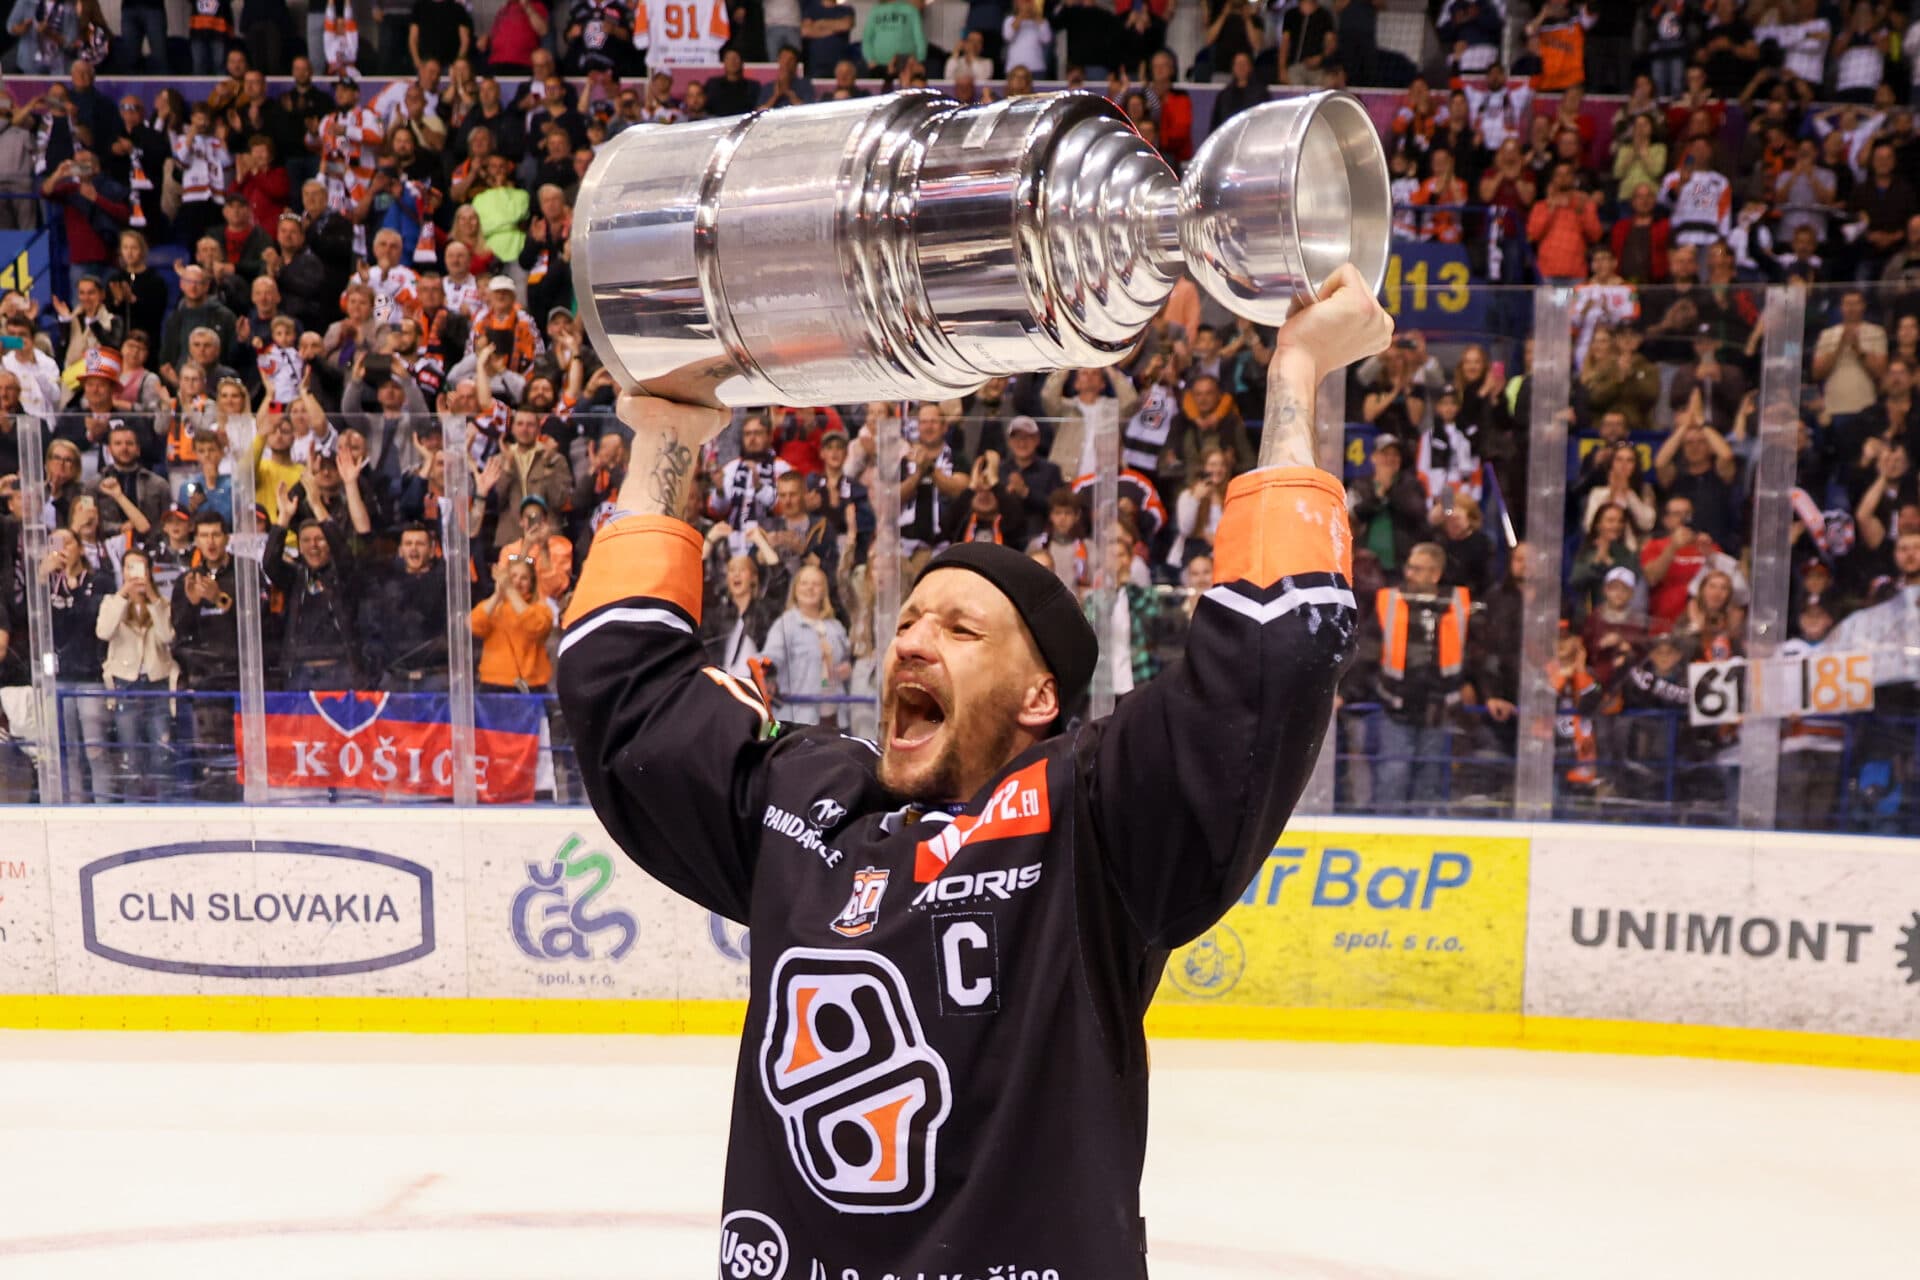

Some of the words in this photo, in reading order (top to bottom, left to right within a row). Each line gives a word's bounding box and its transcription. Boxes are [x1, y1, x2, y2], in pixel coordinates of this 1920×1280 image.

[665, 4, 699, 39] 91
[1694, 665, 1746, 717] 61
[292, 736, 490, 791] KOŠICE
[119, 893, 195, 922] CLN
[208, 893, 400, 922] SLOVAKIA
[1332, 930, 1393, 953] spol.
[1403, 936, 1417, 950] s
[1426, 937, 1465, 953] r.o.
[1571, 906, 1874, 964] UNIMONT
[537, 972, 575, 986] spol.
[942, 920, 994, 1008] C
[722, 1229, 779, 1279] USS
